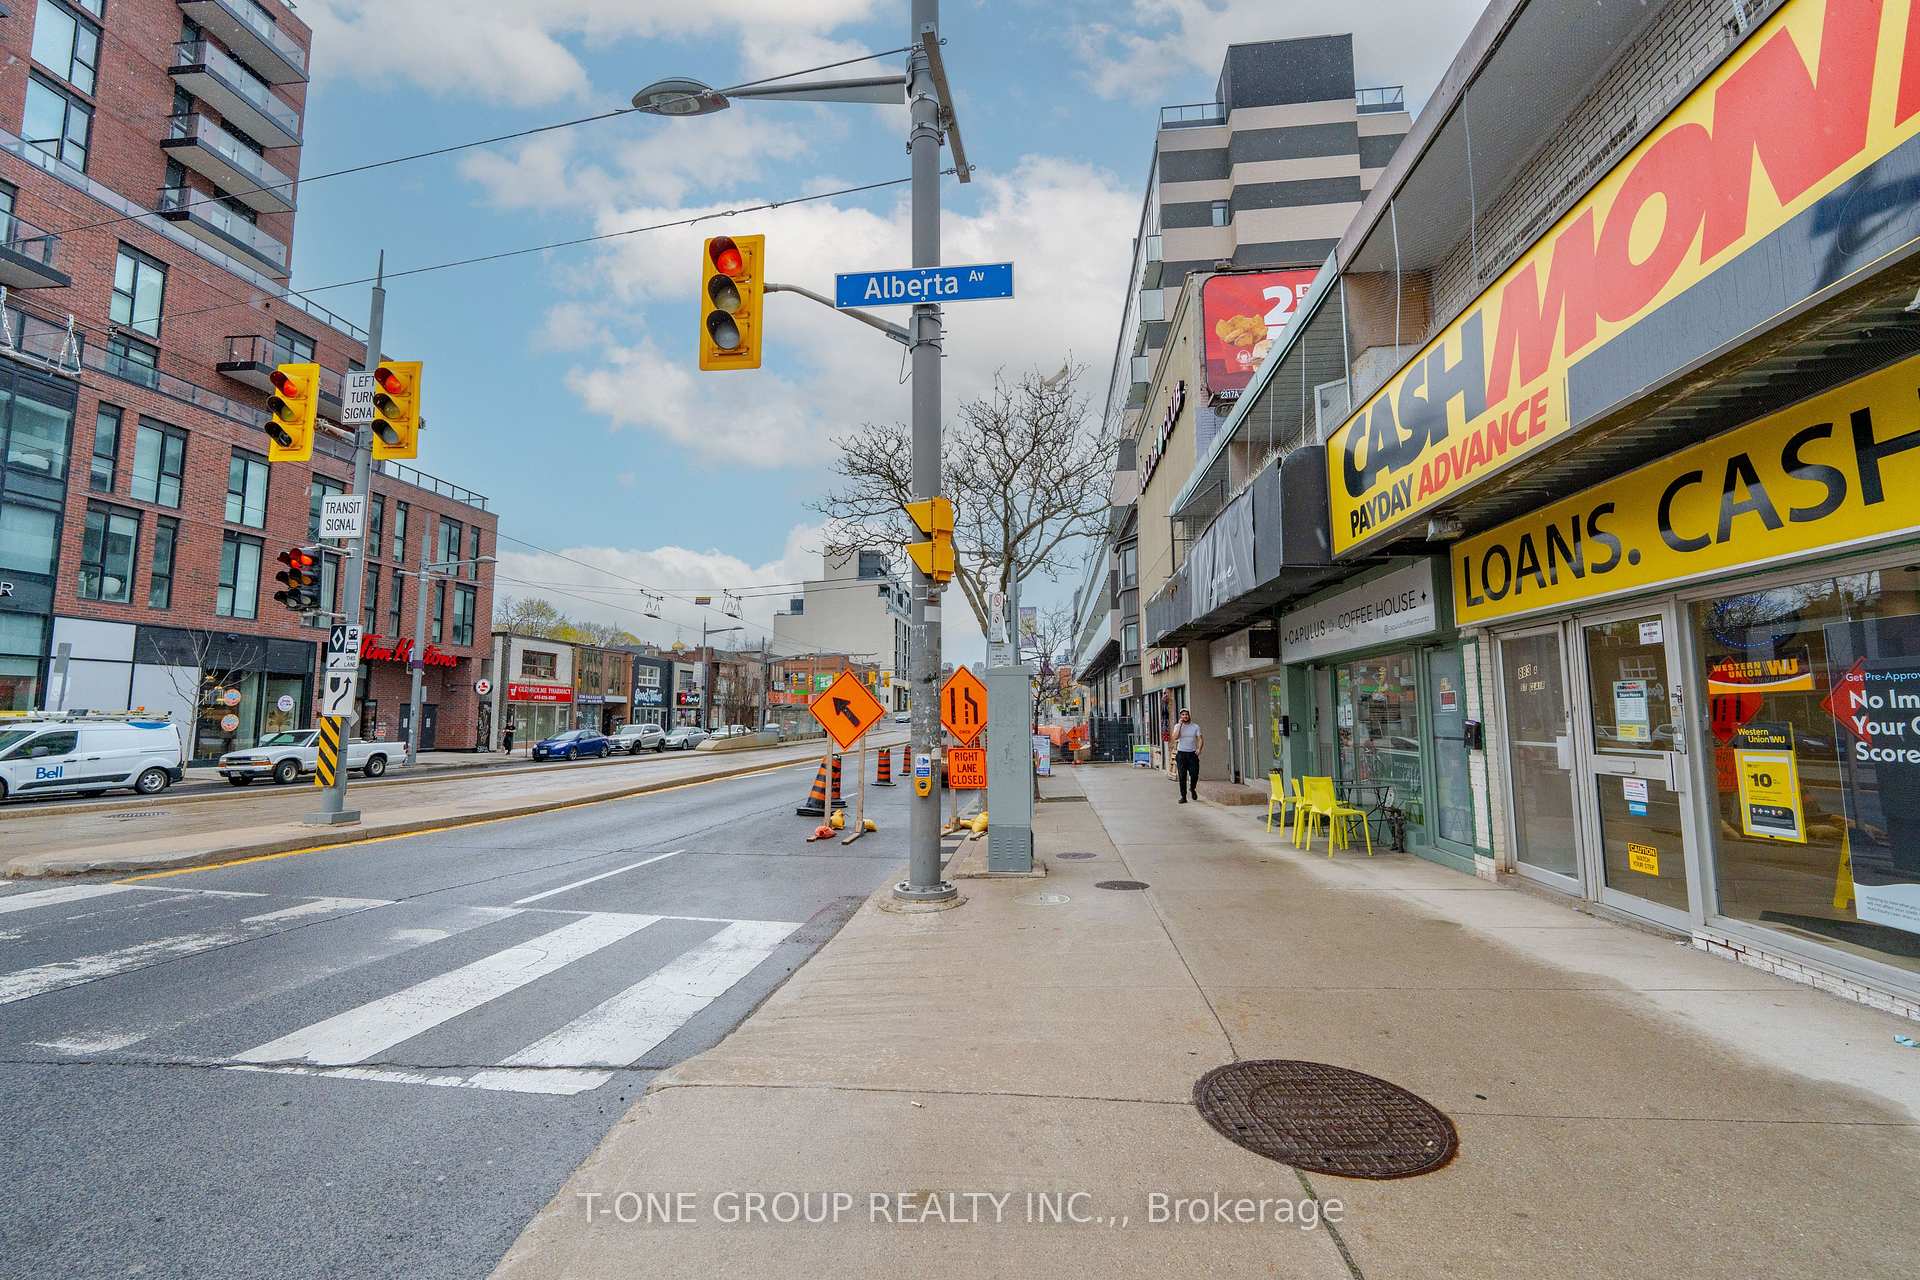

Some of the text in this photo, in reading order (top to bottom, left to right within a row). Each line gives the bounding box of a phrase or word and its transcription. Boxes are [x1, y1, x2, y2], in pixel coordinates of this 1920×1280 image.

[1344, 0, 1920, 498] CASH MON
[864, 270, 984, 299] Alberta Av
[352, 392, 376, 403] TURN
[1220, 391, 1239, 399] 2317A
[1351, 387, 1548, 537] PAYDAY ADVANCE
[1464, 388, 1920, 608] LOANS. CASH
[325, 501, 361, 513] TRANSIT
[325, 518, 356, 530] SIGNAL
[1288, 590, 1417, 645] CAPULUS COFFEE HOUSE
[360, 633, 391, 661] Tim
[1713, 662, 1761, 672] WESTERN
[1767, 658, 1798, 675] WU
[1729, 670, 1762, 678] UNION
[1845, 673, 1864, 681] Get
[1849, 689, 1884, 709] No
[1737, 728, 1768, 736] Western
[1852, 715, 1906, 736] Your
[954, 752, 978, 761] RIGHT
[1856, 741, 1920, 764] Score
[36, 766, 63, 779] Bell
[957, 764, 977, 773] LANE
[951, 775, 984, 785] CLOSED
[1630, 844, 1656, 857] CAUTION
